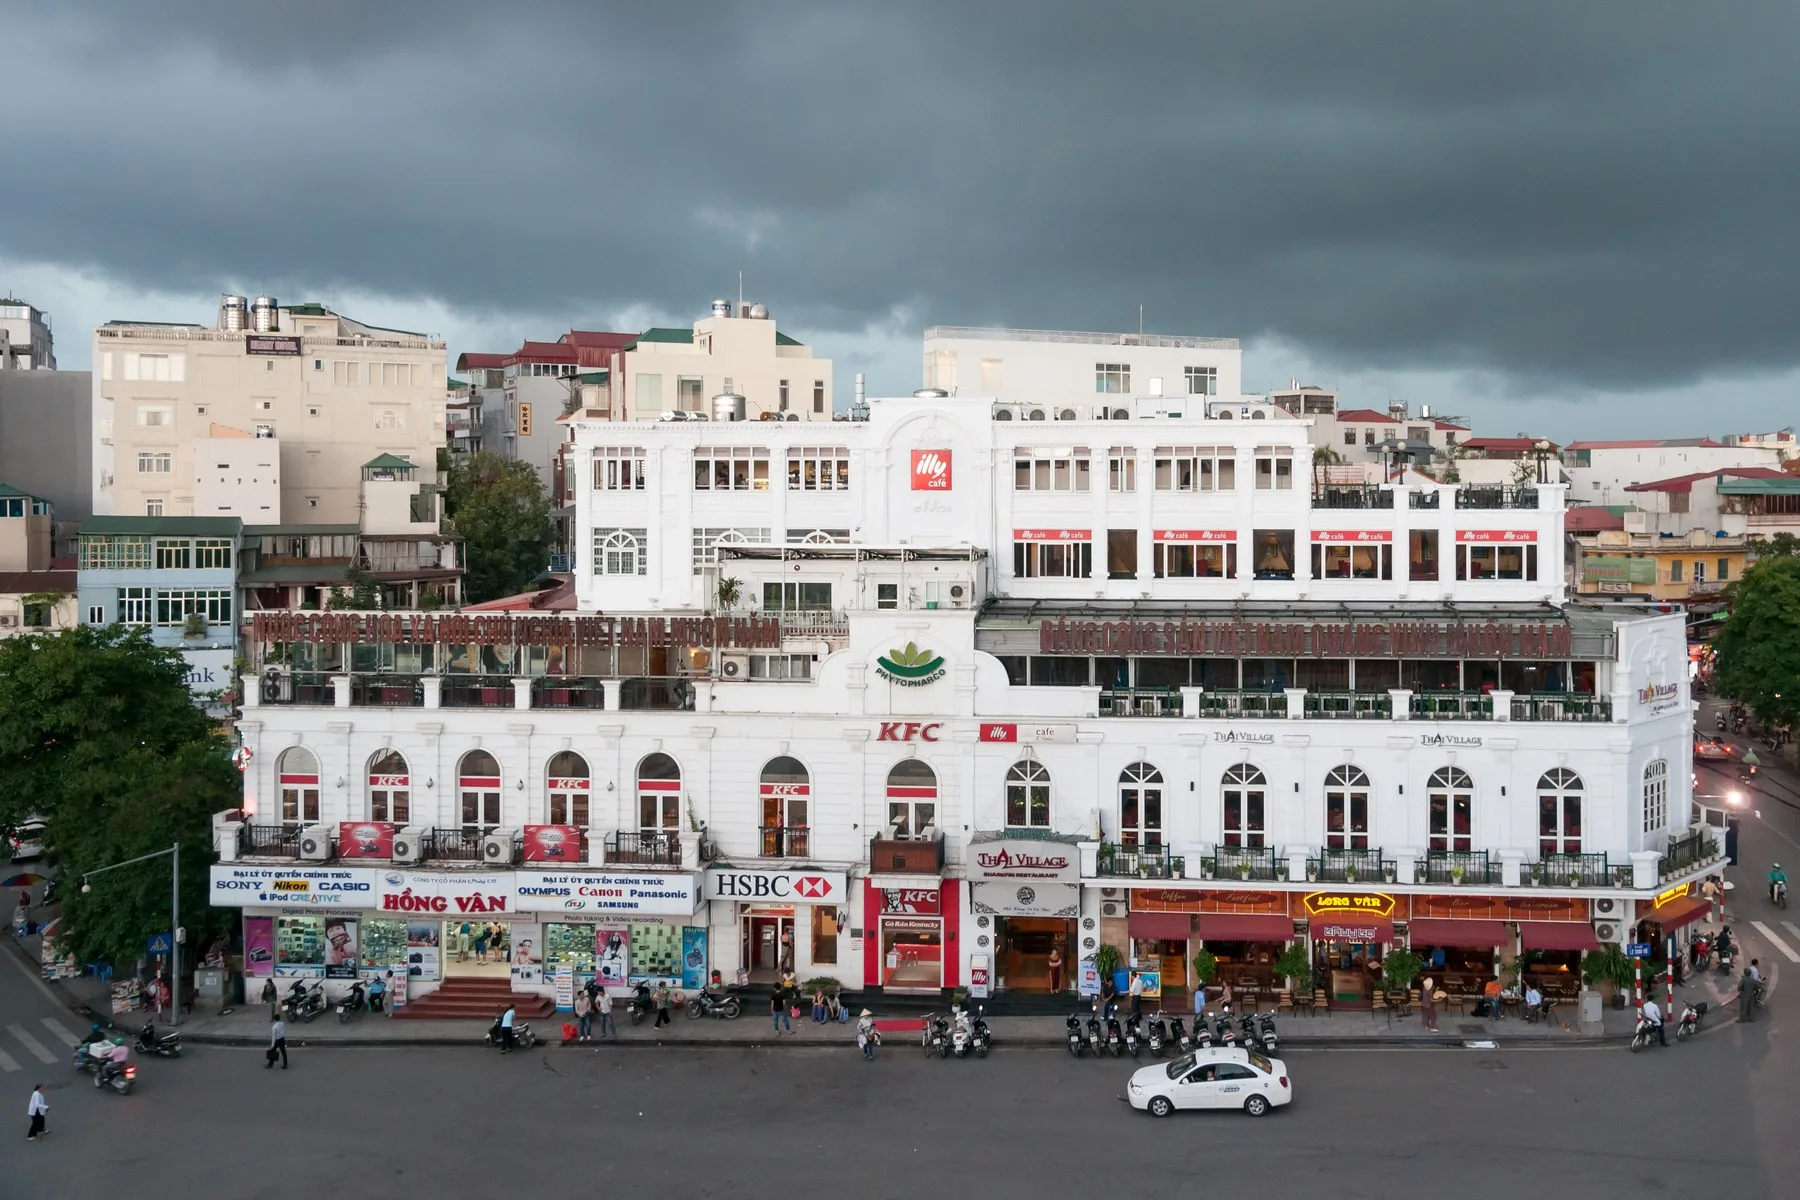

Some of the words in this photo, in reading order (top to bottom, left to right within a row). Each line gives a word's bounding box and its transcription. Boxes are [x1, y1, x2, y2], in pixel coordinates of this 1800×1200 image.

[916, 453, 947, 479] illy
[928, 479, 947, 487] café
[1022, 530, 1033, 539] illy
[1059, 530, 1071, 539] illy
[1164, 530, 1175, 539] illy
[1201, 530, 1214, 539] illy
[1318, 531, 1331, 540] illy
[1358, 531, 1370, 540] illy
[1463, 531, 1476, 540] illy
[1503, 531, 1516, 540] illy
[620, 617, 665, 647] NAM
[1256, 623, 1305, 656] NAM
[1311, 624, 1385, 657] QUANG
[1389, 623, 1439, 657] VINH
[875, 668, 947, 688] PHYTOPHARCO
[876, 722, 940, 742] KFC
[990, 726, 1007, 740] illy
[1036, 727, 1054, 735] café
[1239, 732, 1275, 742] VILLAGE
[1446, 735, 1482, 745] VILLAGE
[377, 777, 404, 786] KFC
[556, 780, 584, 789] KFC
[771, 785, 800, 795] KFC
[1015, 854, 1067, 866] VILLAGE
[216, 880, 263, 890] SONY
[273, 881, 308, 891] Nikon
[318, 882, 370, 891] CASIO
[716, 874, 790, 897] HSBC
[518, 886, 571, 896] OLYMPUS
[578, 886, 623, 897] Canon
[629, 889, 688, 899] Panasonic
[904, 891, 937, 902] KFC
[269, 893, 288, 901] iPod
[290, 894, 342, 902] CREATIVE
[383, 886, 449, 911] HỒNG
[455, 892, 507, 912] VÂN
[597, 901, 639, 909] SAMSUNG
[583, 915, 605, 923] taking
[909, 921, 939, 929] Kentucky
[972, 971, 986, 983] illy
